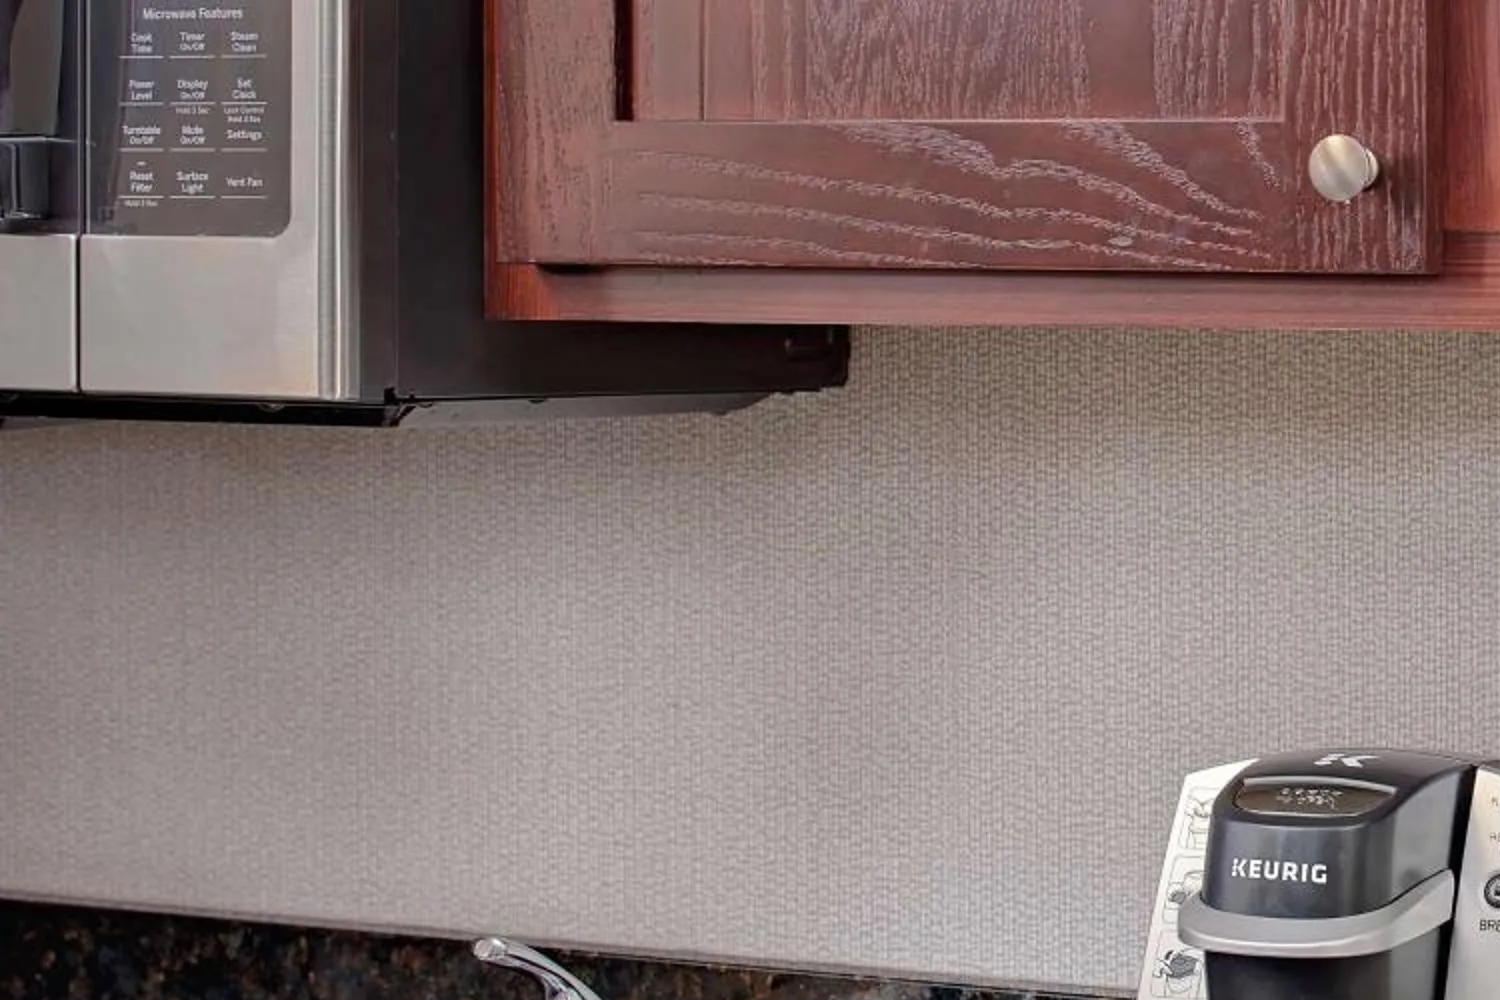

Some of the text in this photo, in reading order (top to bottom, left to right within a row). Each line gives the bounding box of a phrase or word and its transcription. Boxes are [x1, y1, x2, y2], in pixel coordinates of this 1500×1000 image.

[143, 8, 243, 20] Microwave Features
[179, 32, 205, 42] Timer
[230, 32, 259, 42] Steam
[128, 80, 155, 90] Power
[177, 79, 209, 91] Display
[236, 79, 252, 89] Set
[131, 91, 153, 101] Level
[231, 90, 257, 100] Clock
[122, 125, 161, 135] Turntable
[226, 129, 263, 141] Settings
[129, 171, 153, 181] Reset
[176, 171, 209, 181] Surface
[130, 182, 153, 193] Filter
[225, 177, 264, 188] Vent Fan
[181, 183, 204, 195] Light
[1230, 857, 1328, 884] KEURIG
